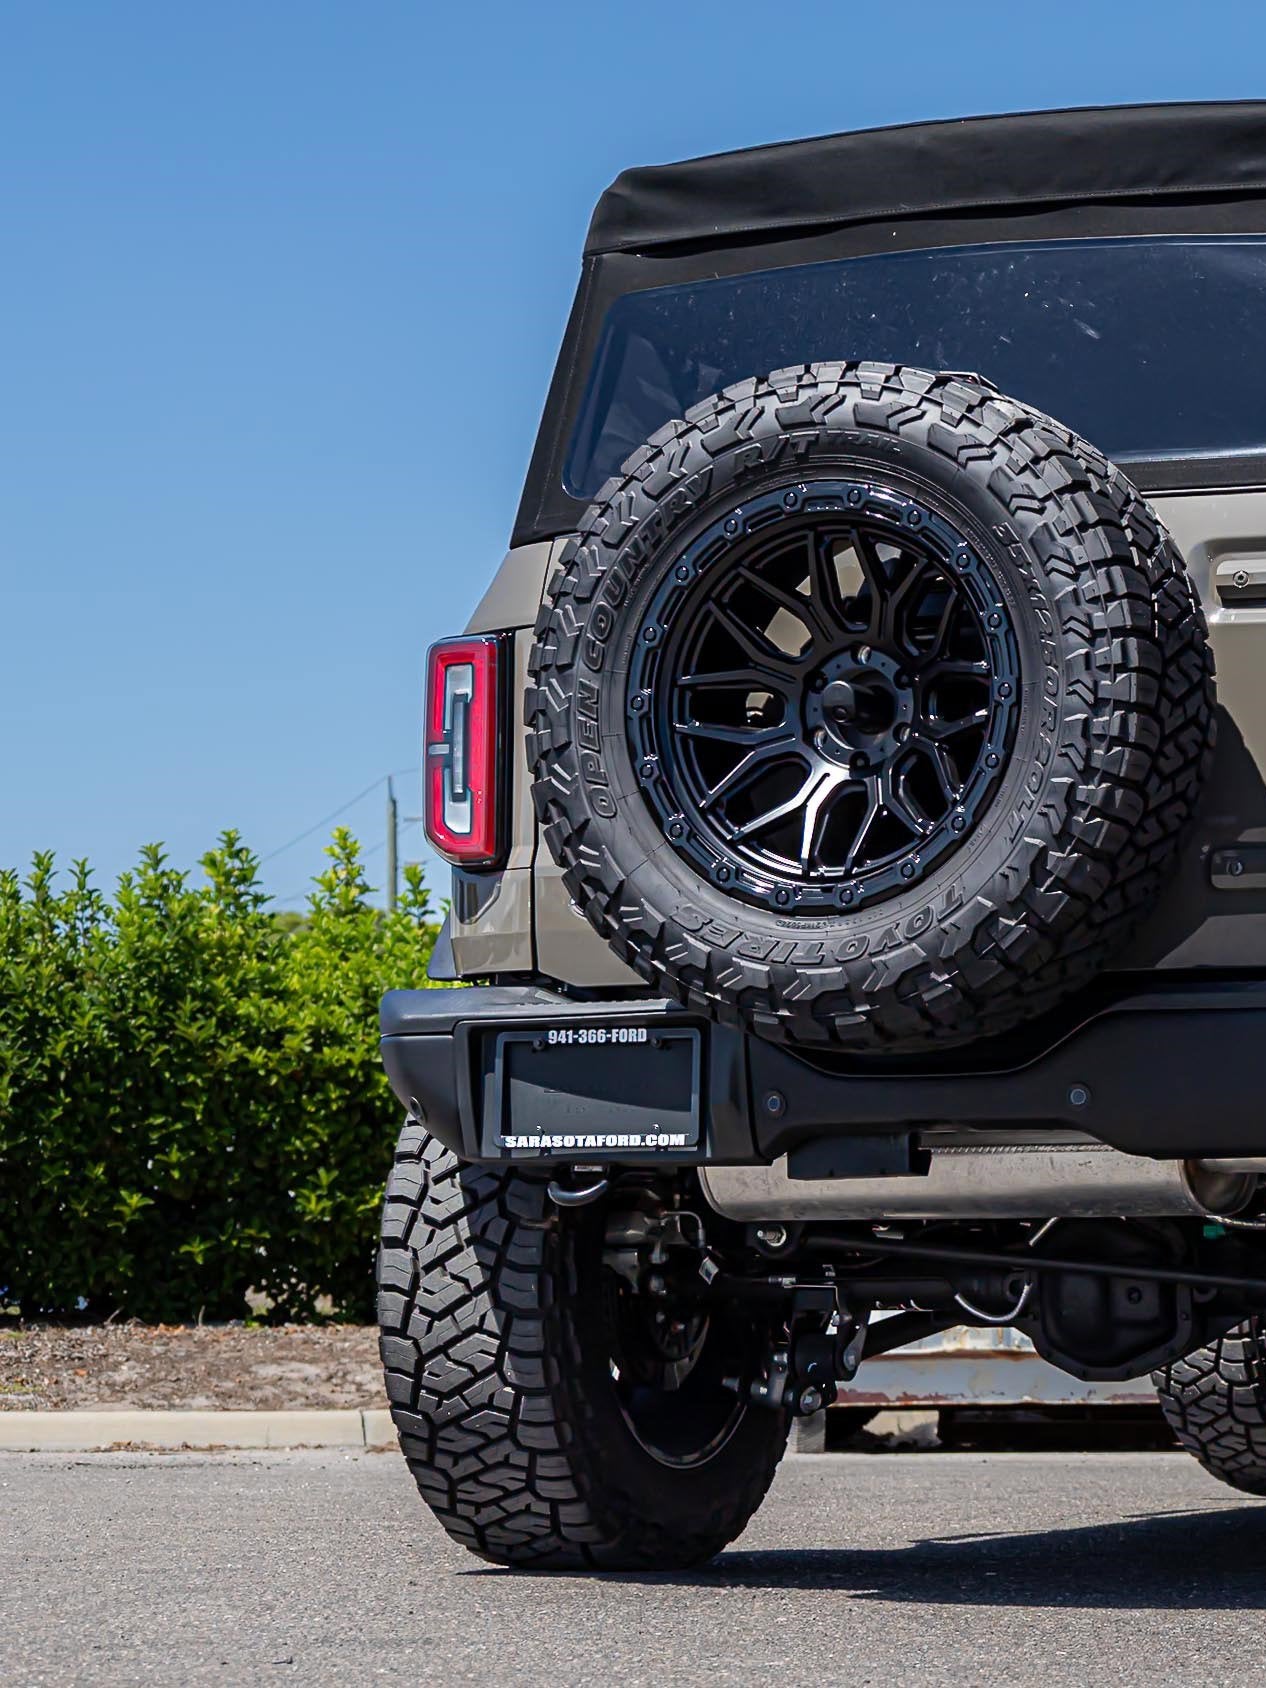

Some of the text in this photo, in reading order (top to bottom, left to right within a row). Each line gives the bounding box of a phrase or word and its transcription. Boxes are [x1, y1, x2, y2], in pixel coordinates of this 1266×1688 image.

[734, 430, 820, 478] R/T
[582, 463, 714, 671] COUNTRY
[576, 678, 617, 819] OPEN
[670, 883, 966, 965] TOYO TIRES
[547, 1028, 648, 1044] 941-366-FORD
[504, 1134, 686, 1148] SARASOTAFORD.COM
